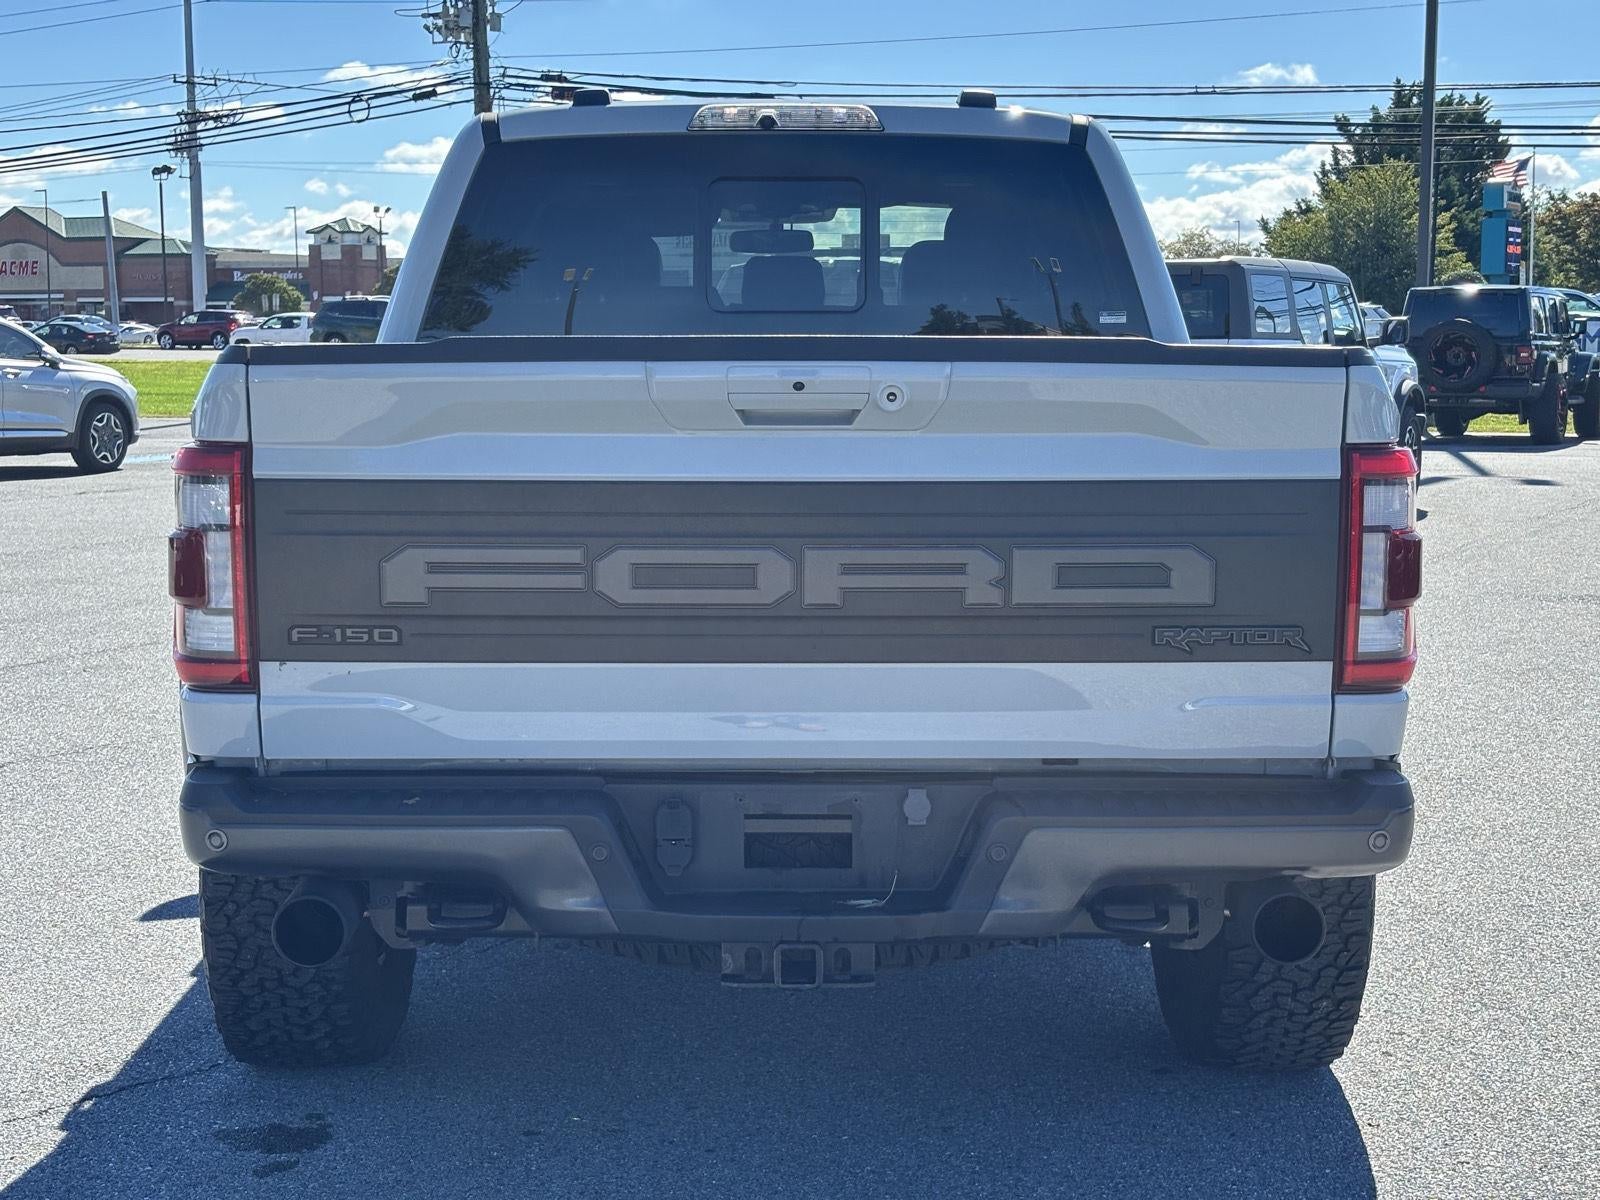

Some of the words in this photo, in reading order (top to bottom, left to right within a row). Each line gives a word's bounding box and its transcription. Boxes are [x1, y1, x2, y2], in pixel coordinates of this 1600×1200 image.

[0, 260, 39, 276] ACME
[379, 543, 1216, 608] FORD
[289, 626, 400, 643] F-150
[1154, 627, 1312, 653] RAPTOR
